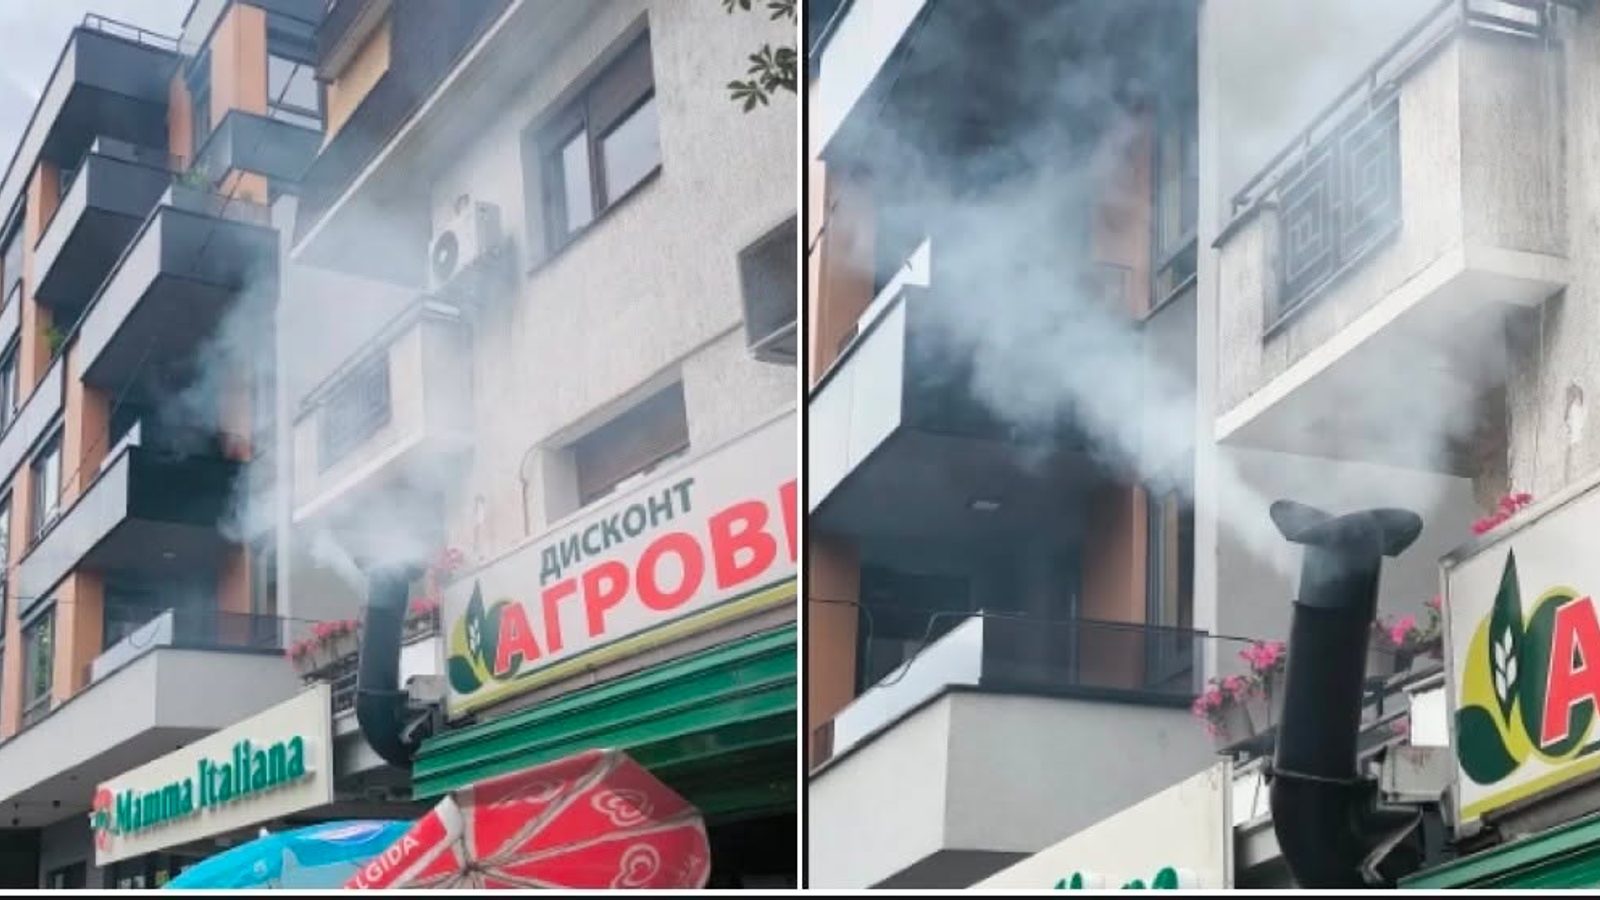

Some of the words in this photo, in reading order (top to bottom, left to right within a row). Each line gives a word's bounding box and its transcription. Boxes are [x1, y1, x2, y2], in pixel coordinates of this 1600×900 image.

[539, 477, 695, 586] ДИСКОНТ
[116, 777, 194, 834] Mamma
[198, 735, 305, 808] Italiana
[343, 836, 419, 889] LGIDA
